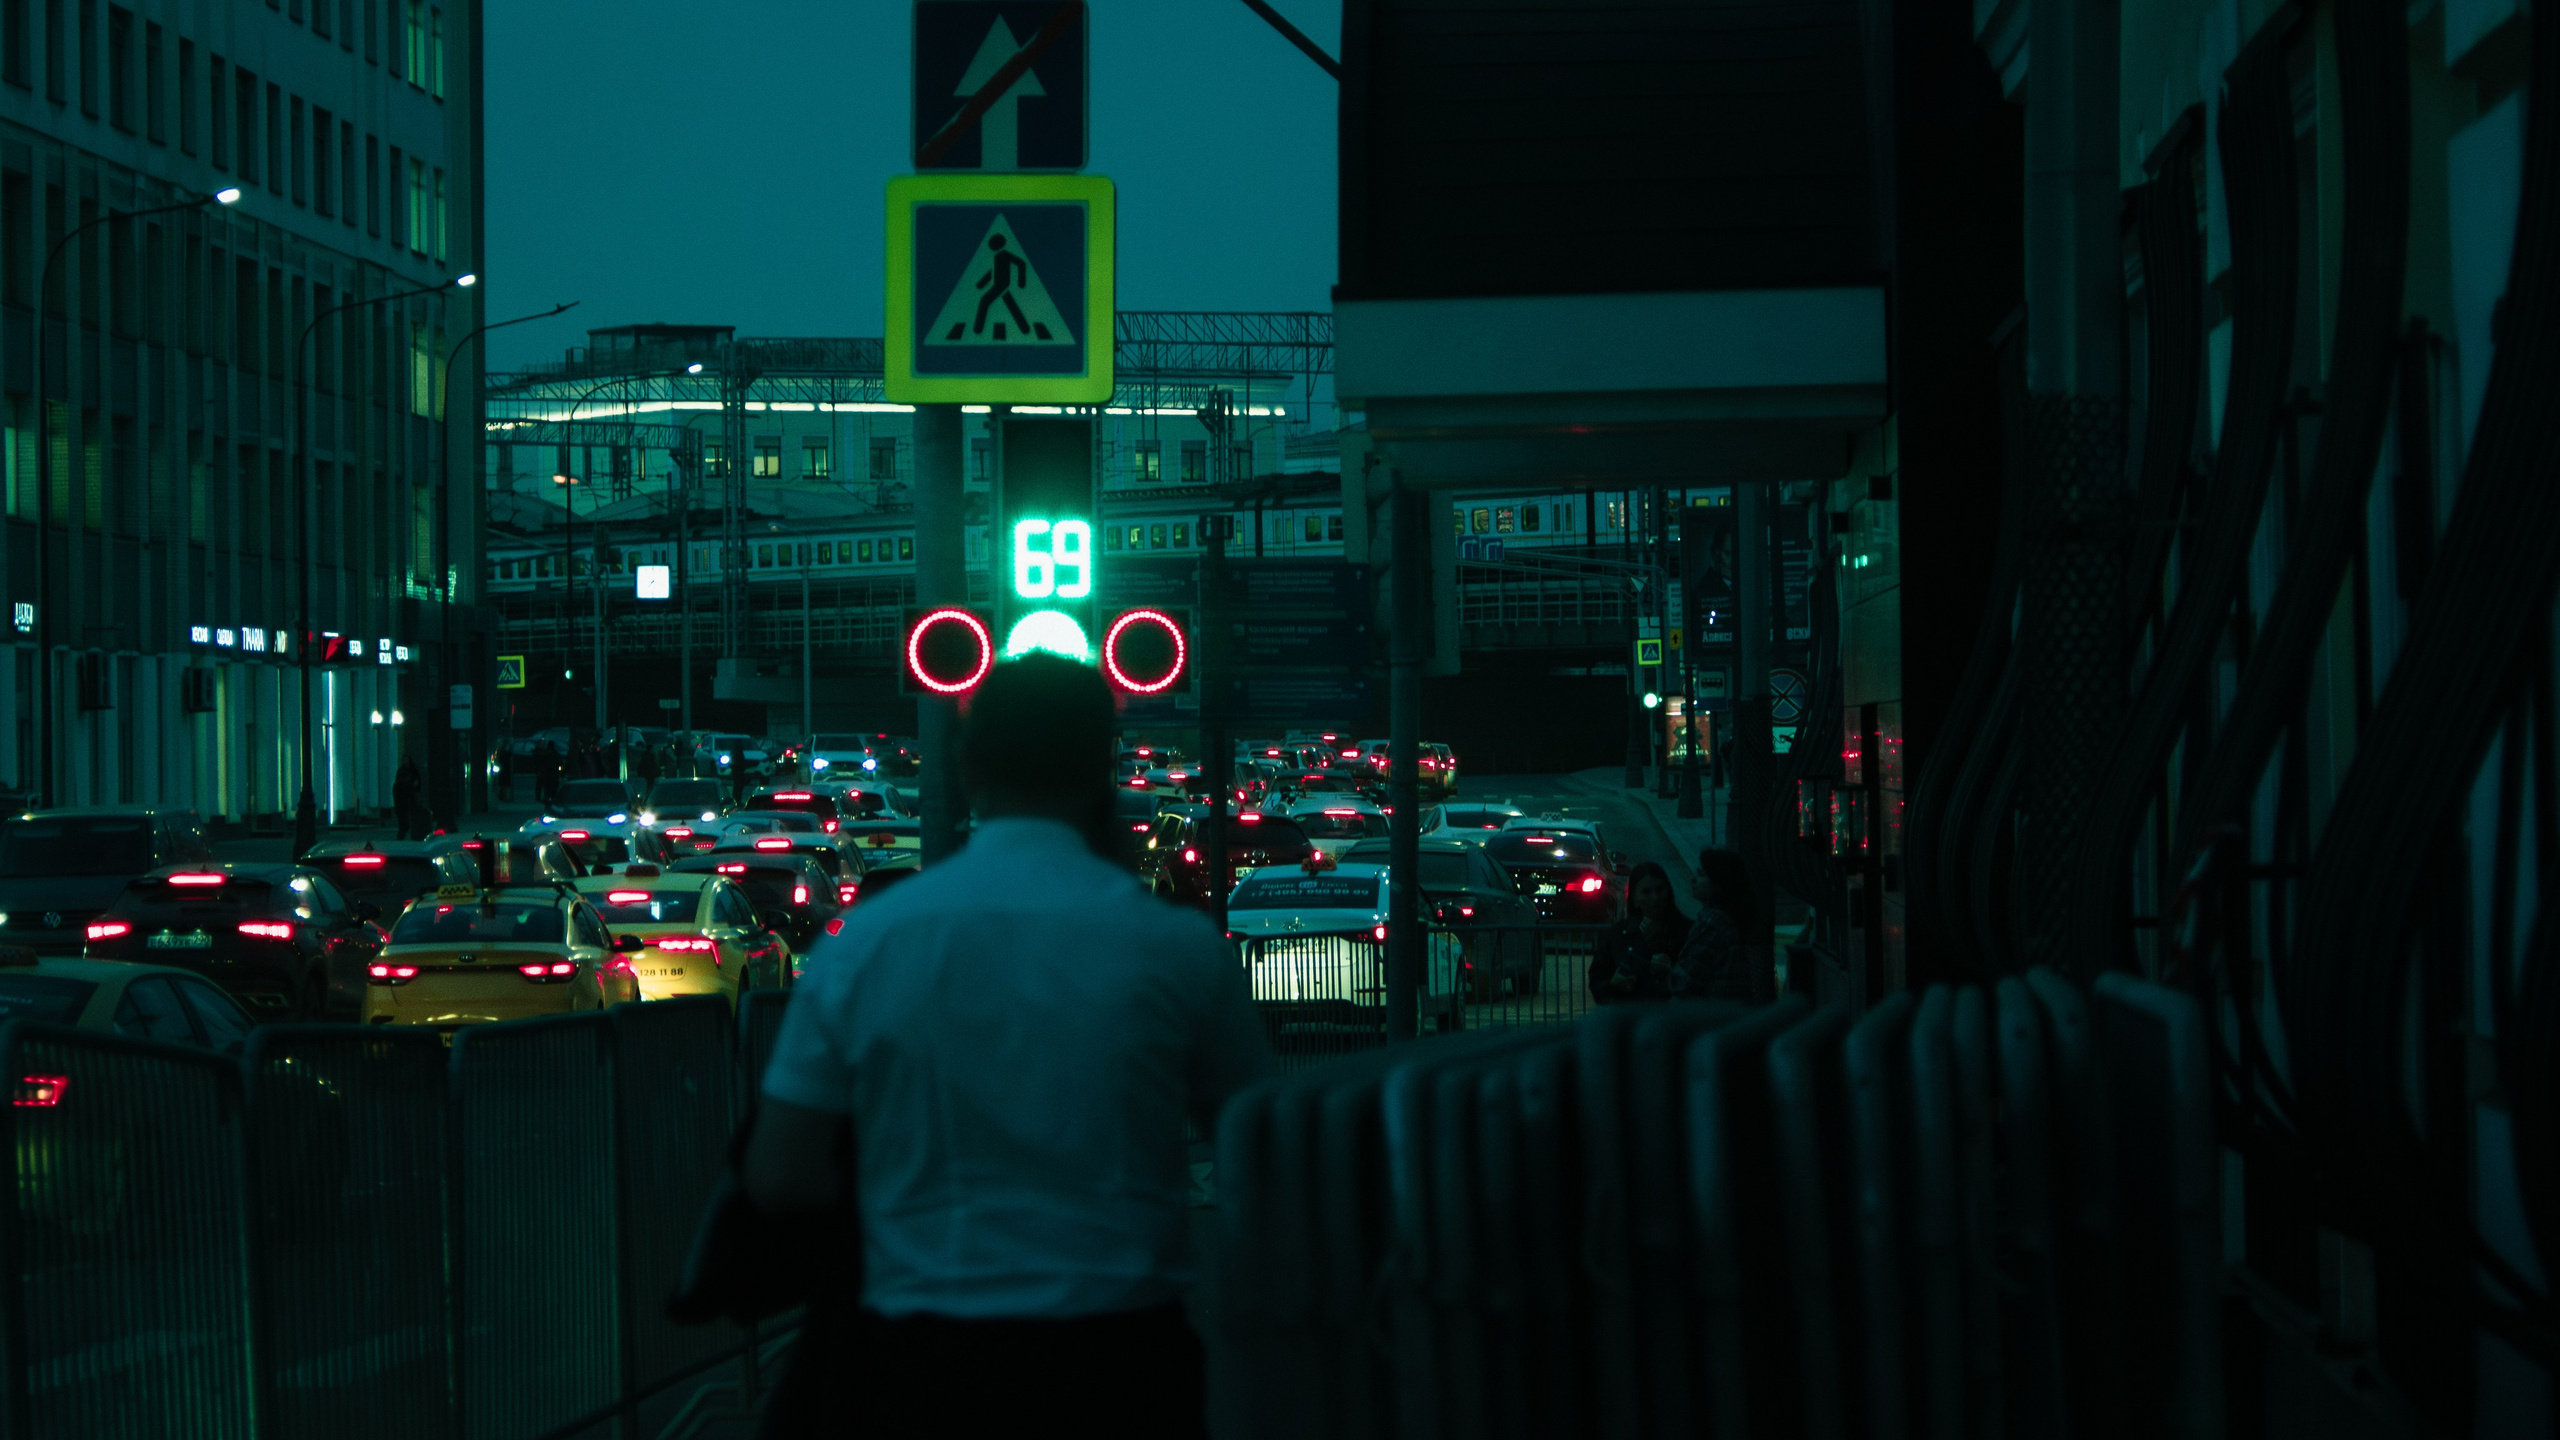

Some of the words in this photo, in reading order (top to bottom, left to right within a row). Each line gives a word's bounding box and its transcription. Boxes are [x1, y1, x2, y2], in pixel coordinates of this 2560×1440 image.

[1013, 518, 1091, 599] 69
[640, 968, 656, 977] 128
[659, 968, 668, 976] 11
[670, 967, 684, 976] 88
